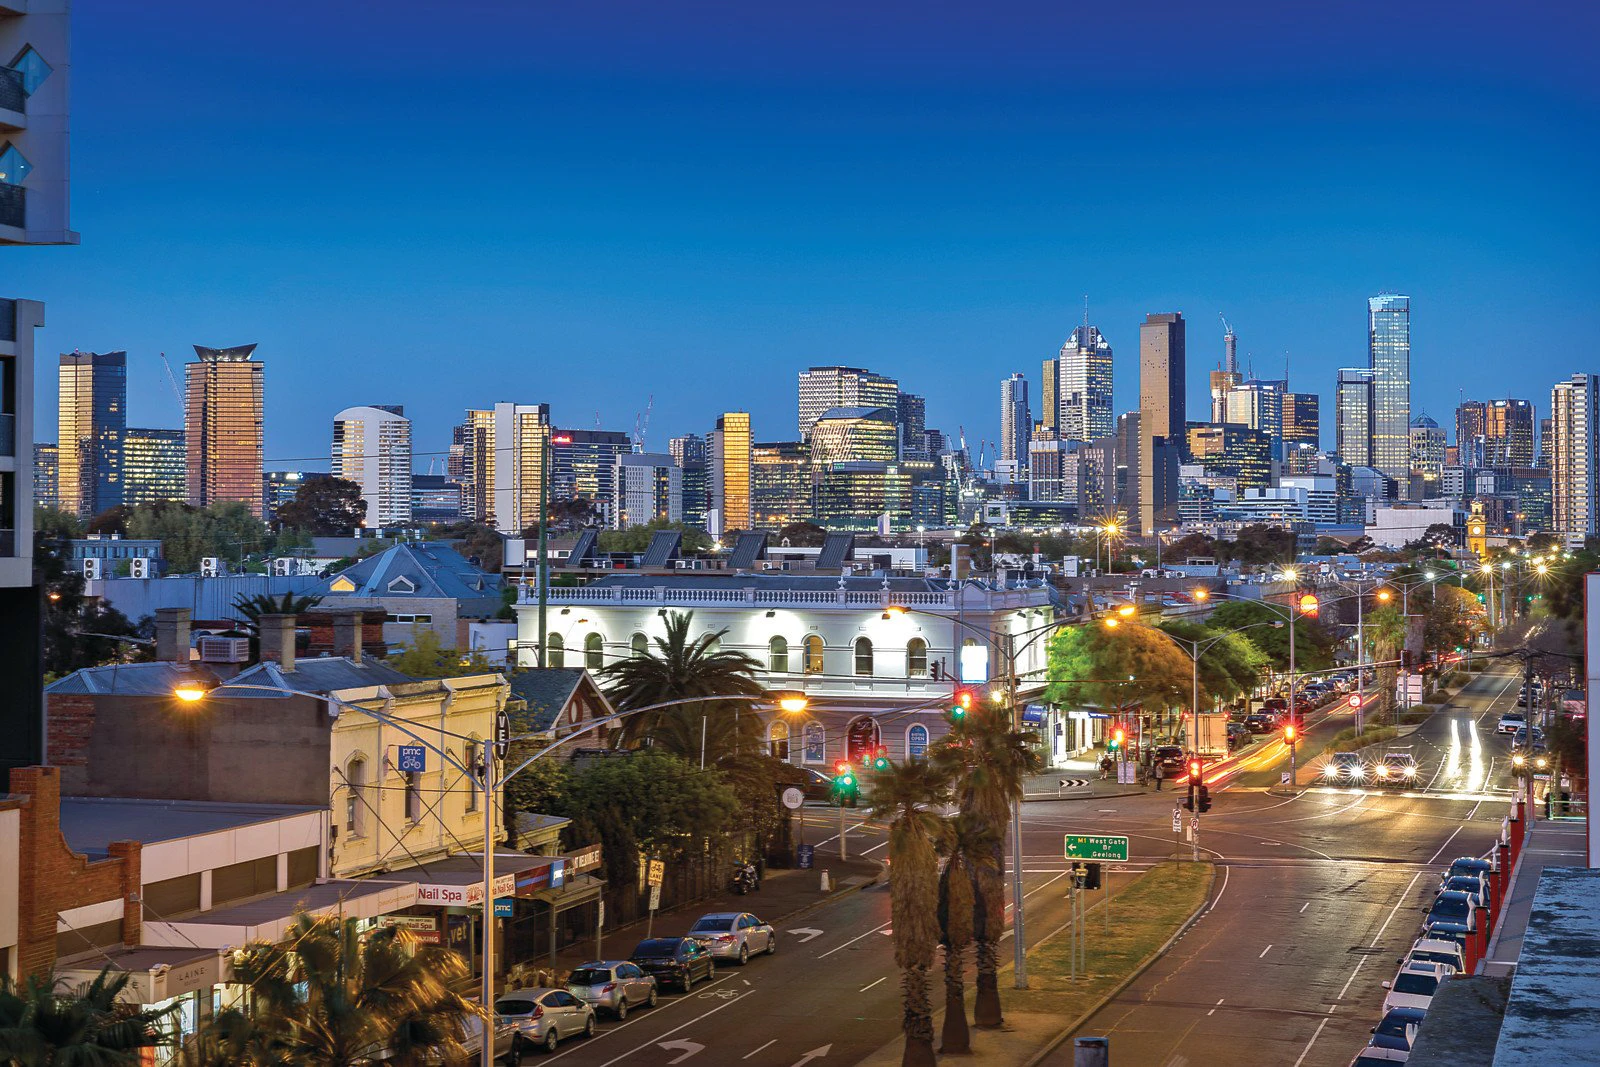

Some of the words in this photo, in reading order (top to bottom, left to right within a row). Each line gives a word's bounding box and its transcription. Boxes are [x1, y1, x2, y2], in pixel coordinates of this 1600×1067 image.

[498, 716, 506, 755] VET
[403, 748, 421, 756] pmc
[1092, 851, 1121, 859] Geelong
[497, 883, 506, 894] Nail
[506, 882, 514, 893] Spa
[418, 888, 439, 900] Nail
[441, 889, 462, 902] Spa
[494, 904, 511, 912] pmc
[419, 922, 432, 931] Spa
[450, 922, 467, 943] vet
